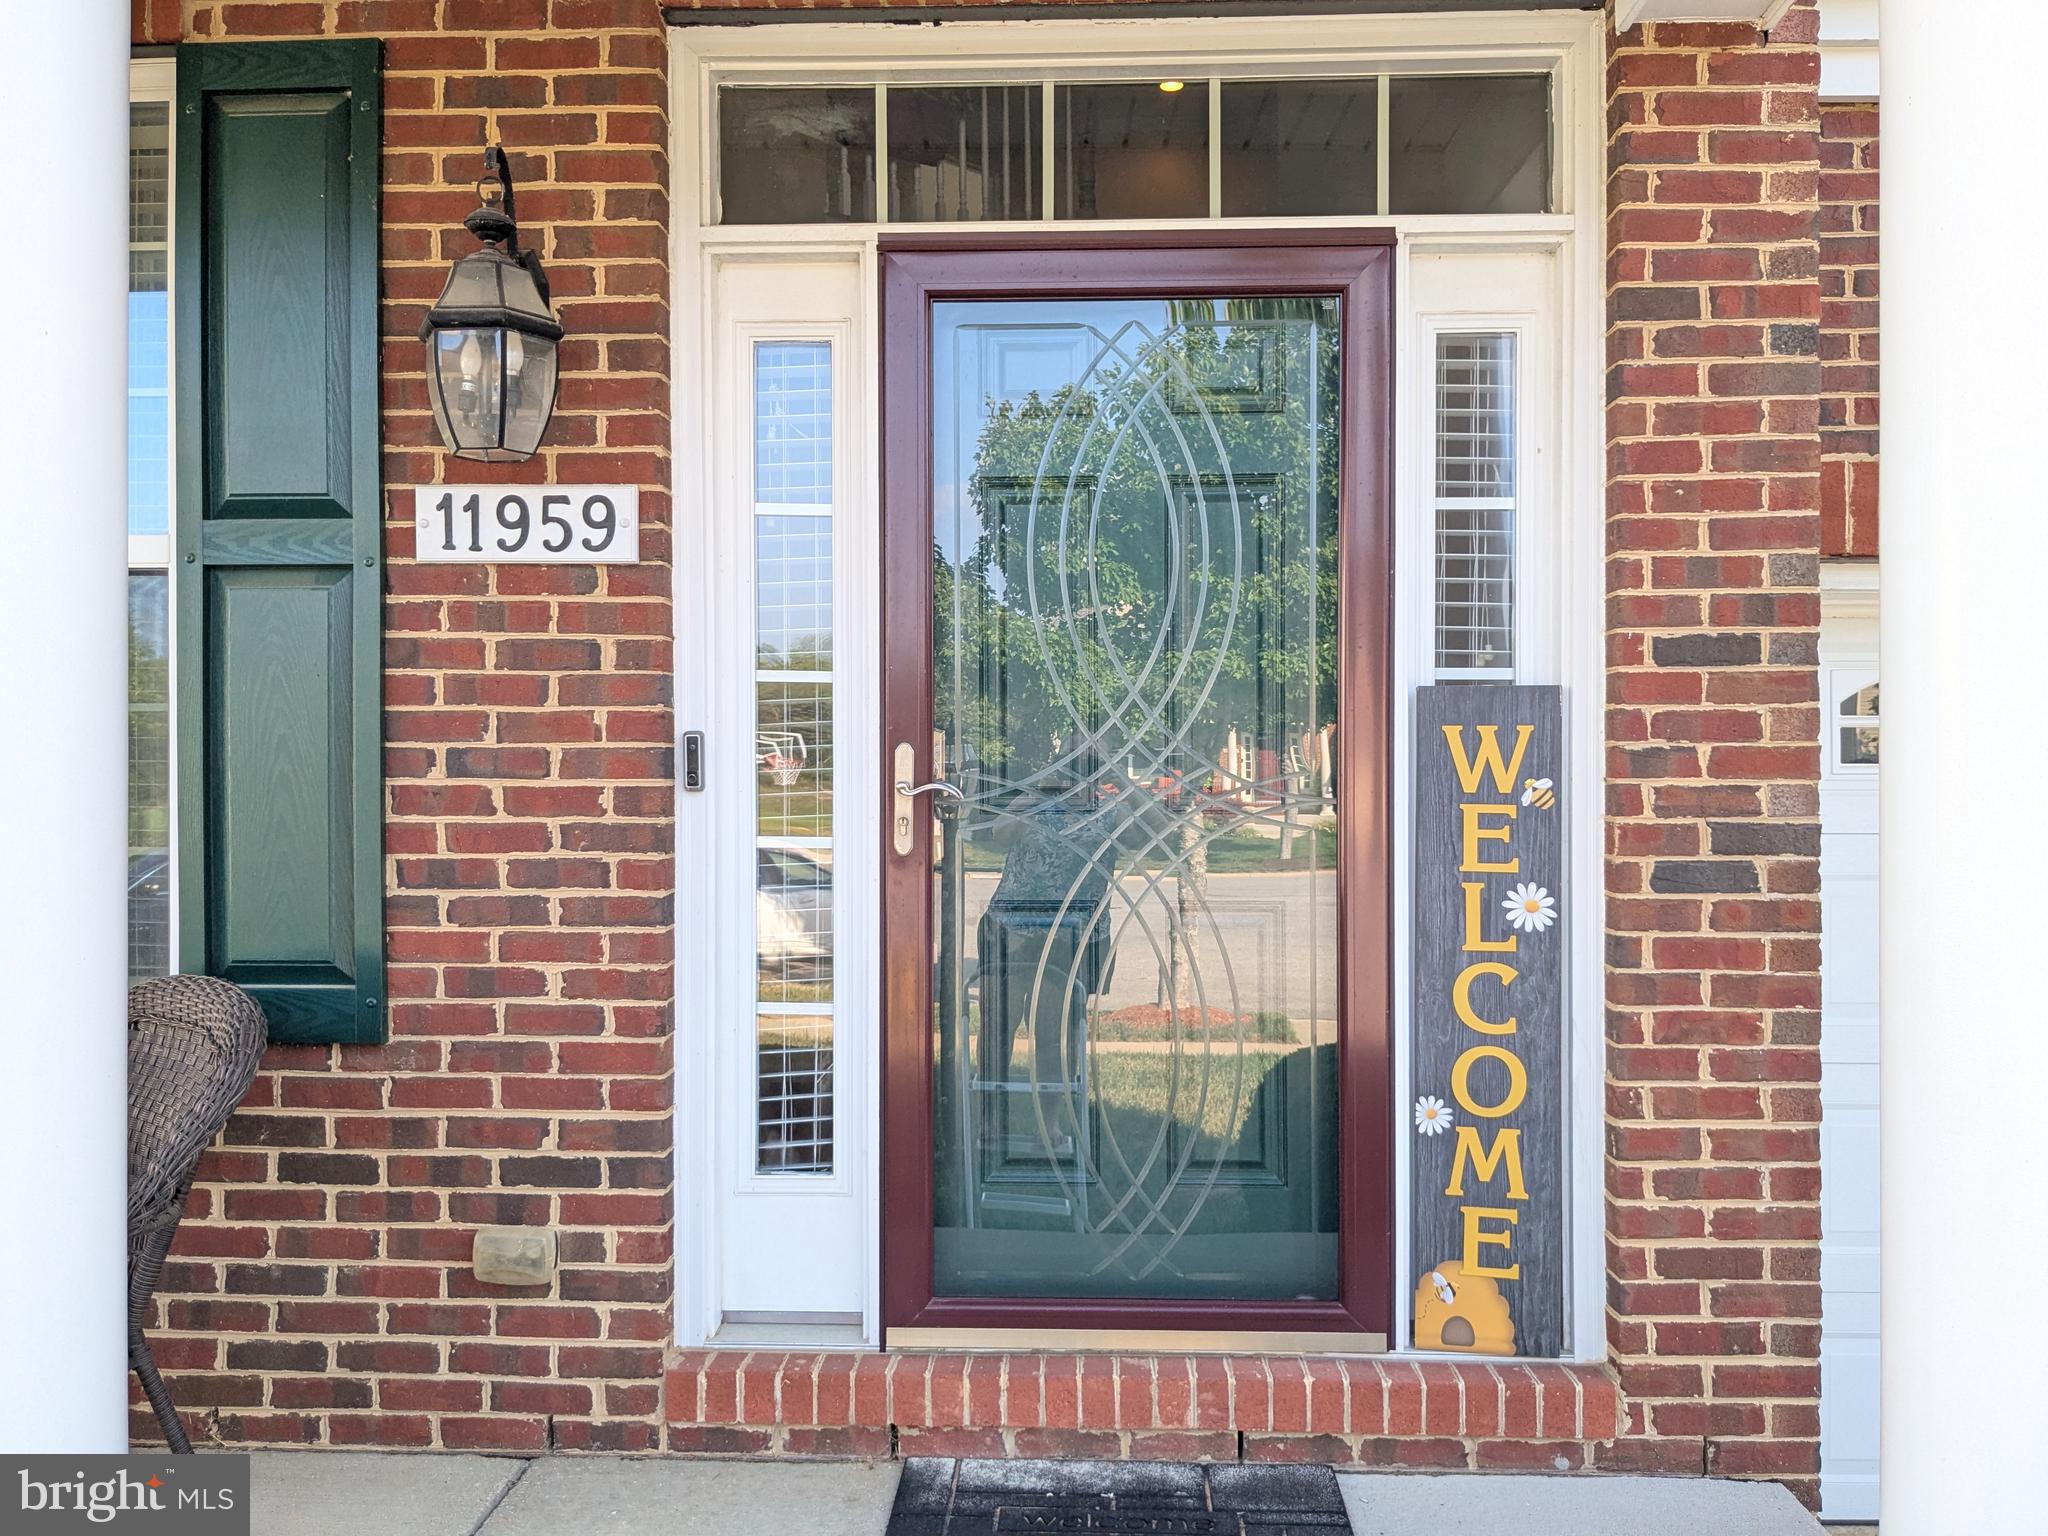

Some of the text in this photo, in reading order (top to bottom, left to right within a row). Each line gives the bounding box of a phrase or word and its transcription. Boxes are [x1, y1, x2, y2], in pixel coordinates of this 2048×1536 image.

[436, 493, 616, 552] 11959
[1443, 725, 1534, 1279] WELCOME
[1023, 1512, 1215, 1531] welcome
